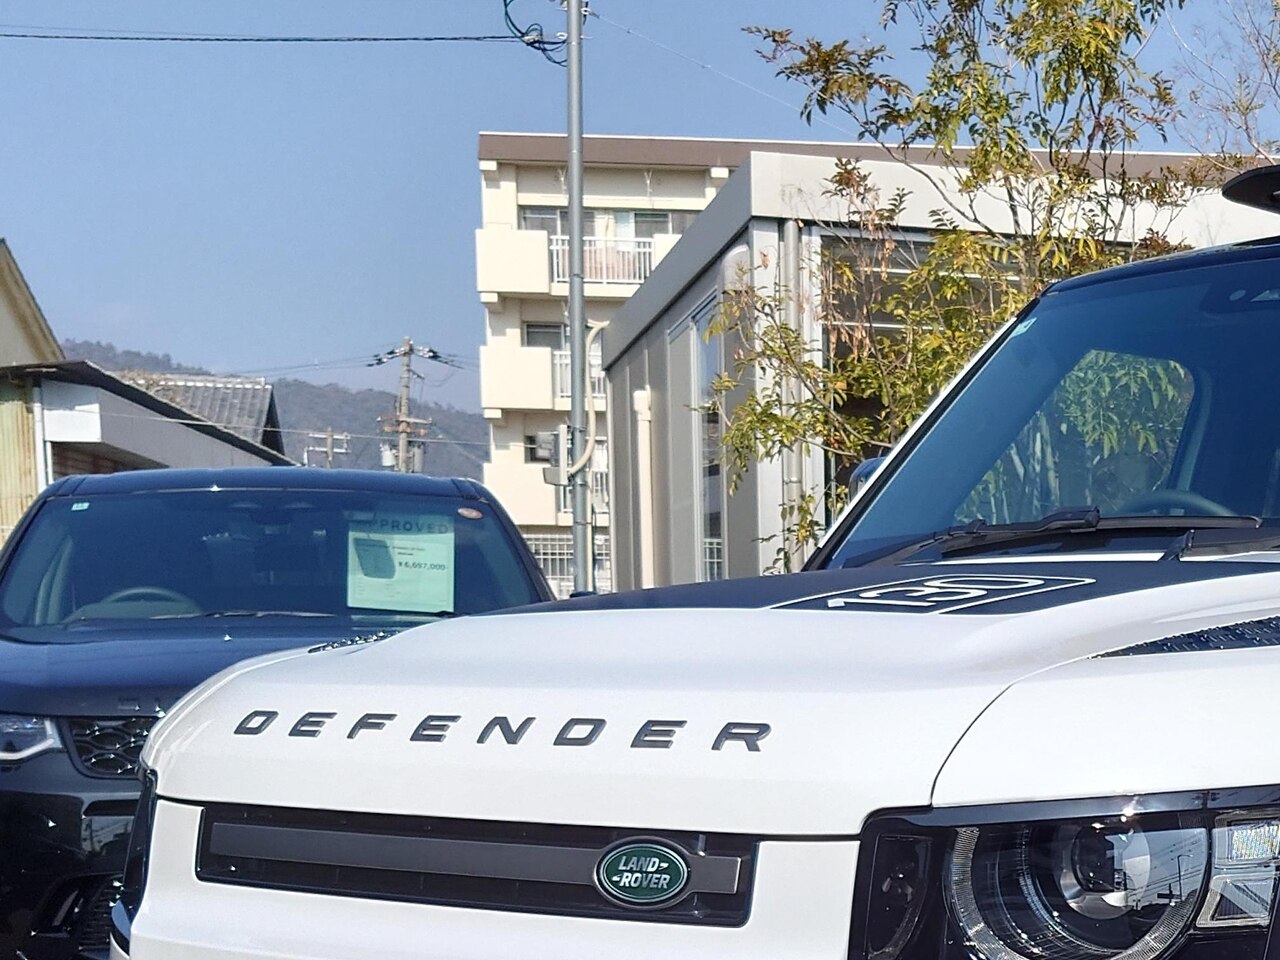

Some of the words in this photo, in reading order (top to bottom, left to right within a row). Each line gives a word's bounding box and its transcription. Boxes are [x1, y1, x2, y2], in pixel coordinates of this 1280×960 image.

[827, 576, 1045, 608] 130
[233, 710, 772, 752] DEFENDER
[618, 855, 661, 872] LAND
[618, 872, 671, 889] ROVER
